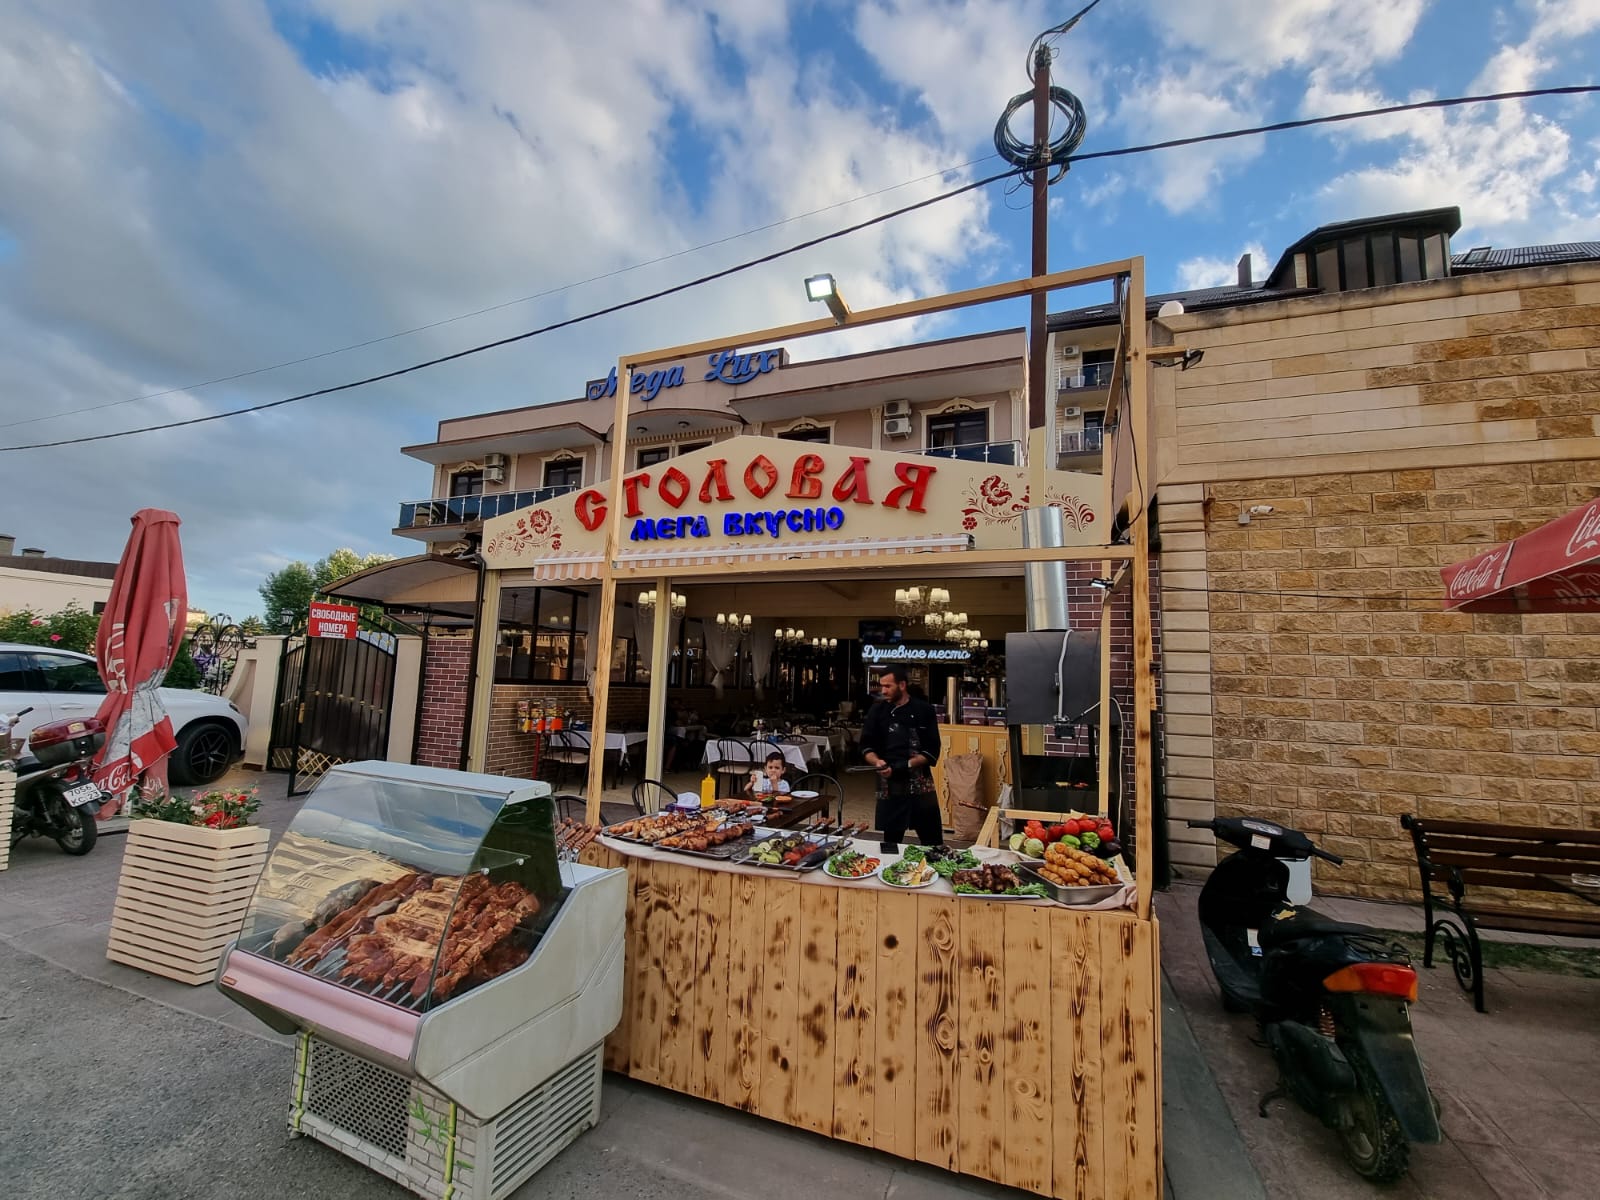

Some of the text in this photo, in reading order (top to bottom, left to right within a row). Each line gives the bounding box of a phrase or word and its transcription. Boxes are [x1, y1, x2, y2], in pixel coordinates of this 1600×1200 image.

[587, 349, 779, 401] Mega Lux
[311, 608, 357, 622] СВОБОДНЫЕ
[318, 621, 348, 634] НОМЕРА
[861, 645, 971, 662] Душевное место
